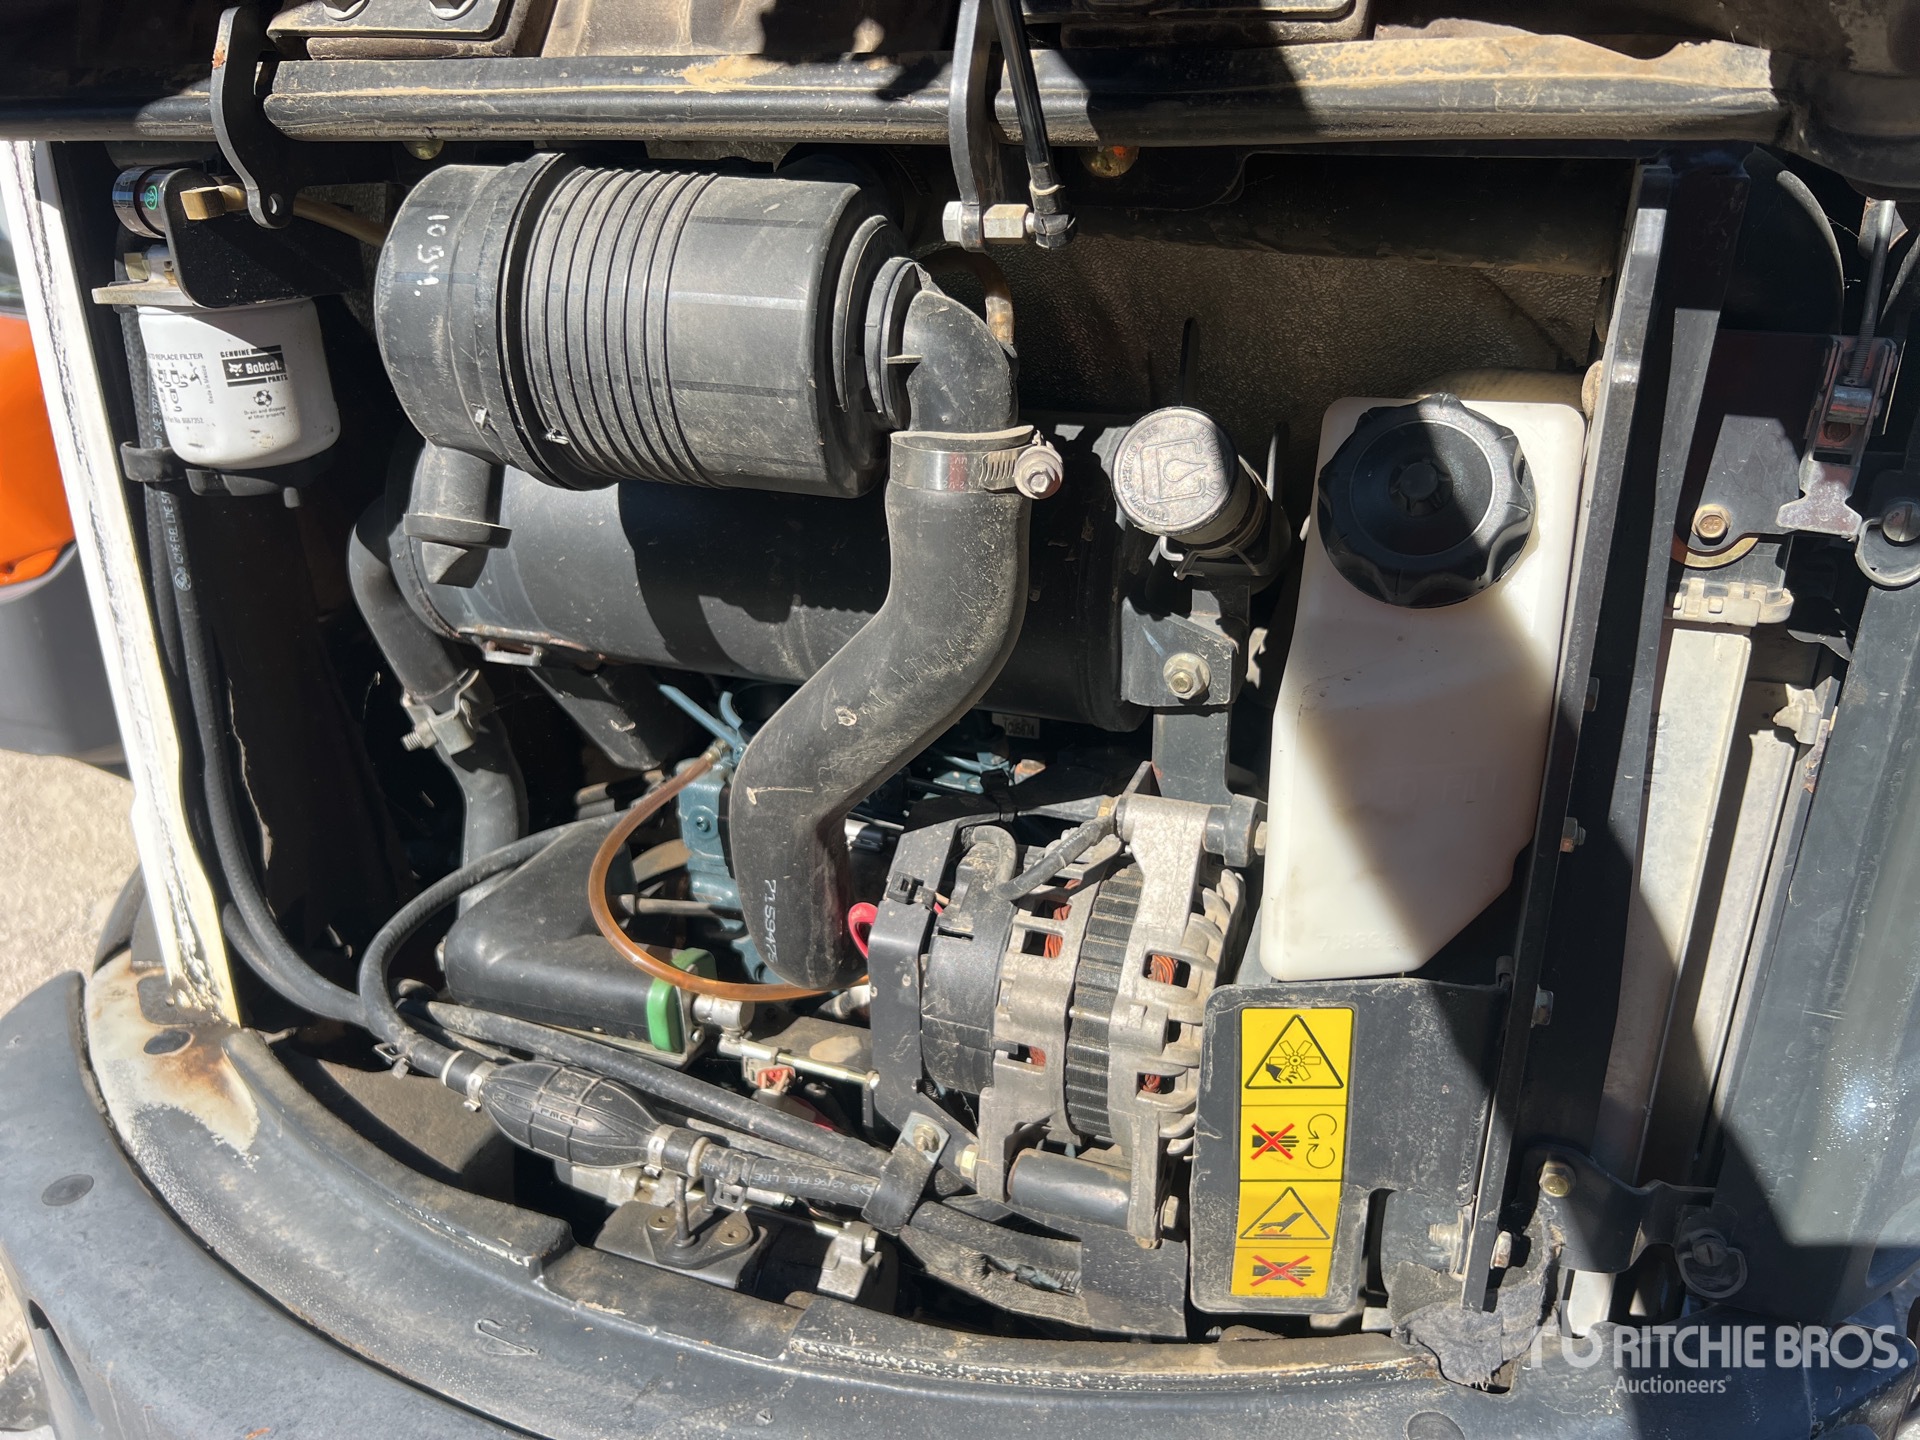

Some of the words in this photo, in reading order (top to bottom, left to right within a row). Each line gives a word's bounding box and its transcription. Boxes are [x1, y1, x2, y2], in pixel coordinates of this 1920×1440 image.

[180, 352, 204, 360] FILTER
[220, 349, 251, 358] GENUINE
[268, 374, 289, 384] PARTS
[268, 406, 287, 414] dispose
[152, 418, 163, 432] SAE
[1140, 423, 1160, 445] SEE
[1202, 480, 1221, 502] OIL
[163, 505, 176, 524] LINE
[1130, 493, 1169, 522] MANUAL
[168, 525, 180, 542] FUEL
[764, 879, 778, 963] 7159475
[754, 1172, 780, 1183] LINE
[786, 1175, 810, 1185] FUEL
